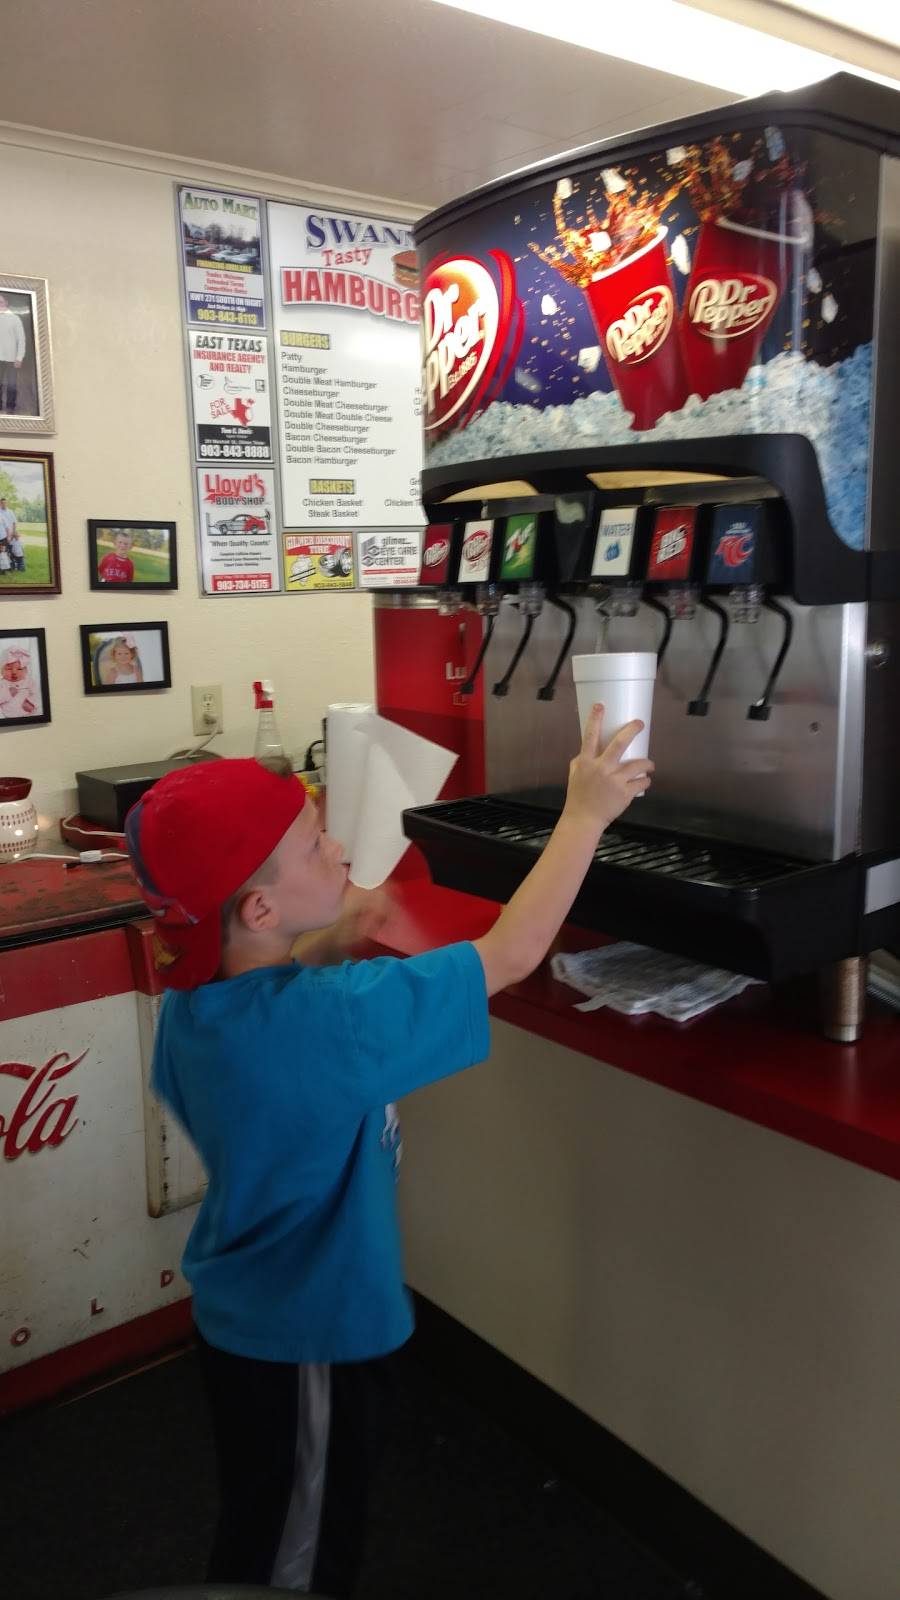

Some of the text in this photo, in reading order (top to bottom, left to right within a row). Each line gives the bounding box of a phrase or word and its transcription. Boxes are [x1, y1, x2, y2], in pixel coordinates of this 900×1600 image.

[183, 192, 257, 220] AUTO MART
[322, 247, 371, 267] Tasty
[721, 279, 757, 306] Dr
[691, 279, 770, 331] Pepper
[424, 284, 460, 358] Dr
[606, 297, 668, 362] Pepper
[196, 335, 262, 352] EAST TEXAS
[282, 332, 328, 348] BURGERS
[193, 350, 265, 364] INSURANCE AGENCY
[281, 352, 302, 362] Patty
[209, 362, 251, 374] AND REALTY
[281, 364, 328, 375] Hamburger
[282, 375, 377, 390] Double Meat Hamburger
[283, 387, 339, 399] Cheeseburger
[210, 398, 226, 410] FOR
[284, 398, 388, 413] Double Meat Cheeseburger
[211, 405, 233, 419] SALE
[284, 410, 392, 422] Double Meat Double Cheese
[285, 421, 369, 434] Double Cheeseburger
[285, 432, 368, 445] Bacon Cheeseburger
[286, 443, 396, 457] Double Bacon Cheeseburger
[286, 455, 357, 467] Bacon Hamburger
[204, 473, 266, 497] Lloyd's
[311, 480, 353, 494] BASKETS
[216, 496, 265, 506] BODY SHOP
[302, 498, 363, 507] Chicken Basket
[384, 498, 414, 507] Chicken
[308, 509, 358, 518] Steak Basket
[602, 524, 632, 537] WATER
[380, 546, 417, 556] EYE CARE
[715, 532, 754, 568] RC
[375, 556, 404, 566] CENTER
